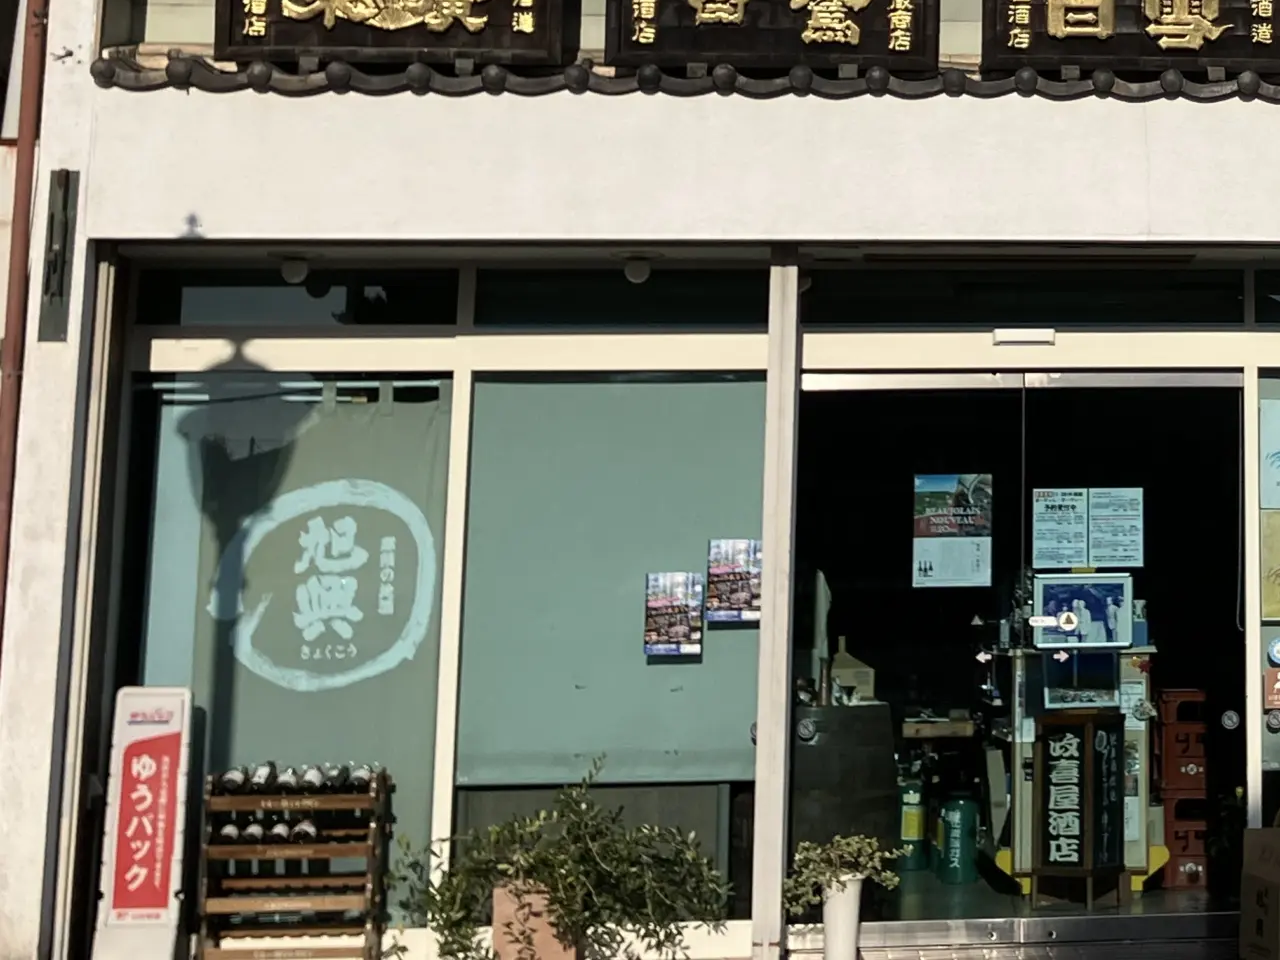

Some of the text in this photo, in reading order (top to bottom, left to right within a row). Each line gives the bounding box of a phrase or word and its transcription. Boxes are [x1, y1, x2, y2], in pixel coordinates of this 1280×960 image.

[300, 643, 358, 661] きょくこう
[124, 753, 157, 893] ゆうパック
